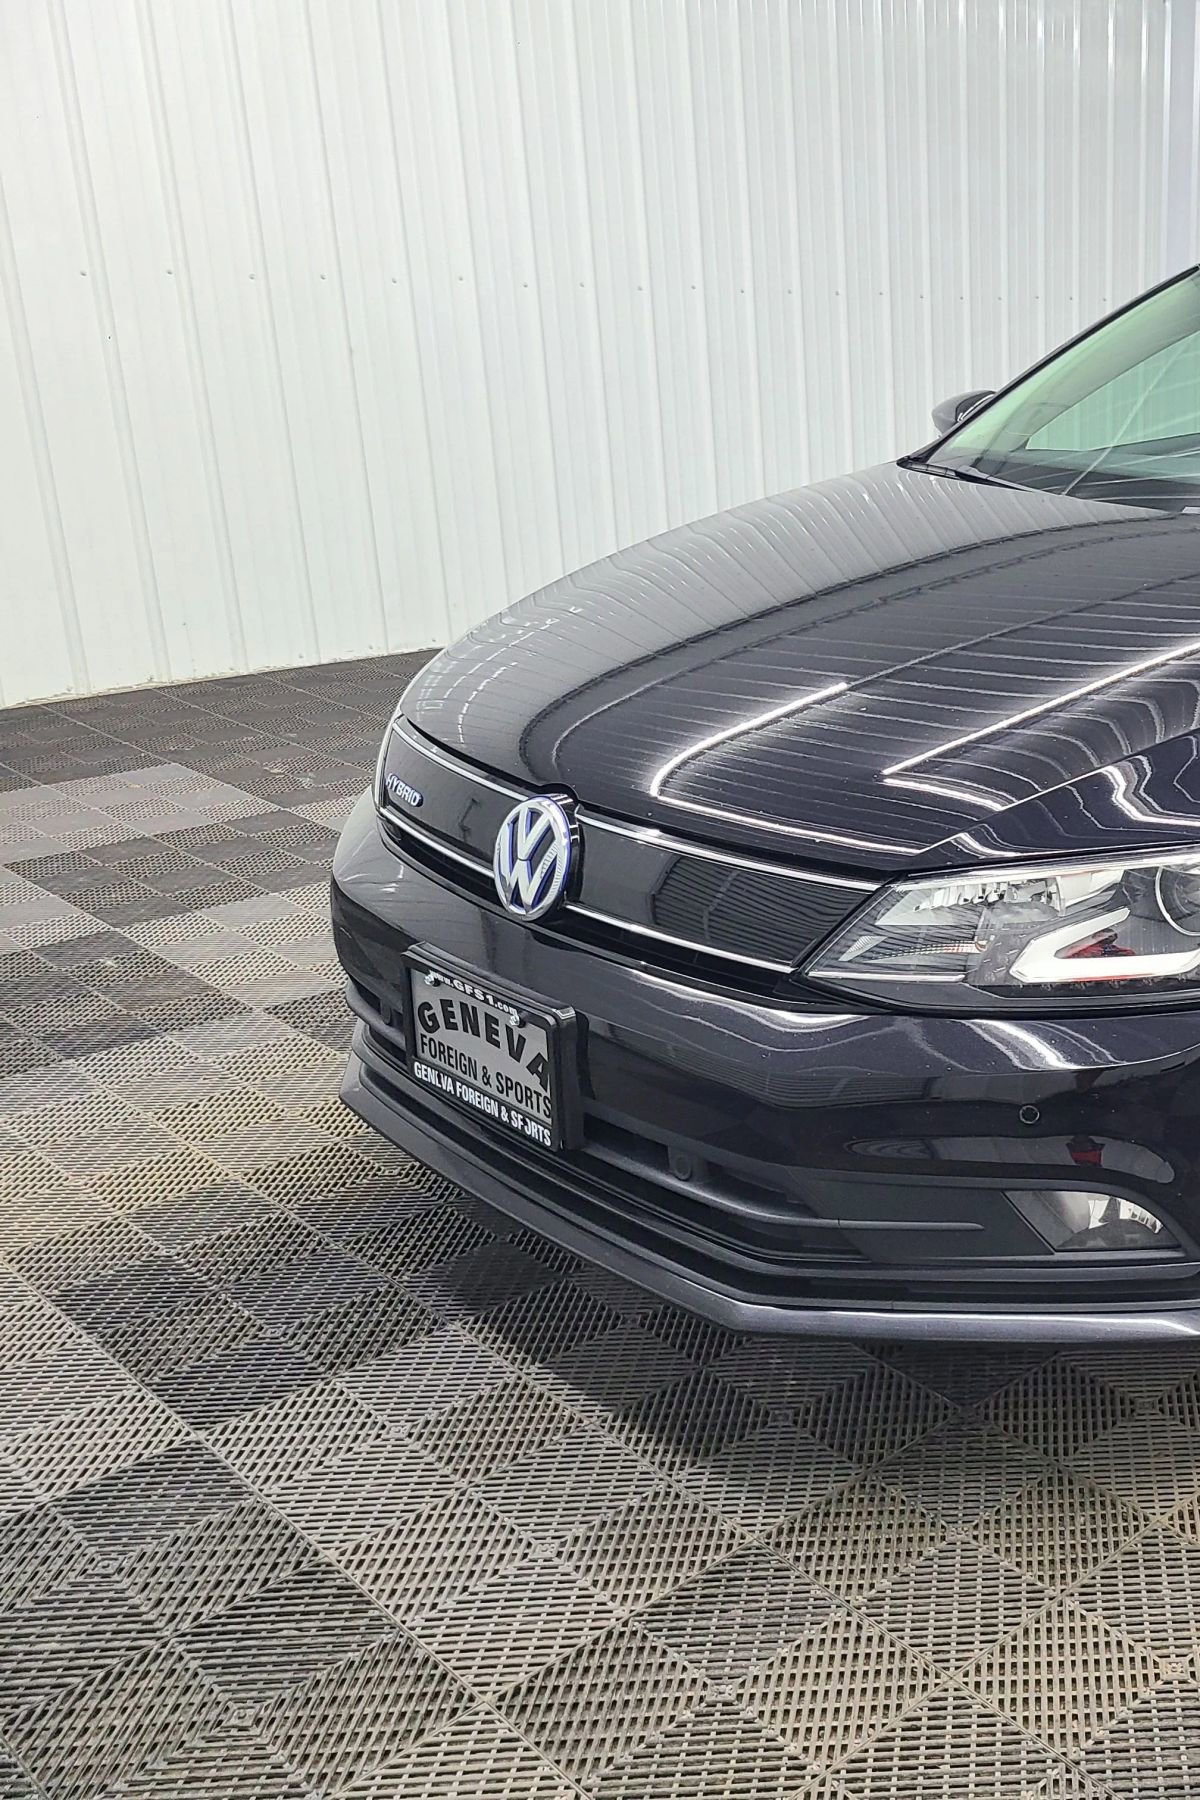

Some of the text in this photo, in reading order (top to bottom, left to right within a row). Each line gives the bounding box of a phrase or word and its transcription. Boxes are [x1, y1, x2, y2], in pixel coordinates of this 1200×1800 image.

[386, 773, 422, 806] HYBRID
[496, 799, 568, 920] VW
[418, 999, 550, 1093] GENEVA
[420, 1033, 551, 1119] FOREIGN & SPORTS
[456, 1081, 499, 1118] FOREIGN
[501, 1105, 510, 1123] &
